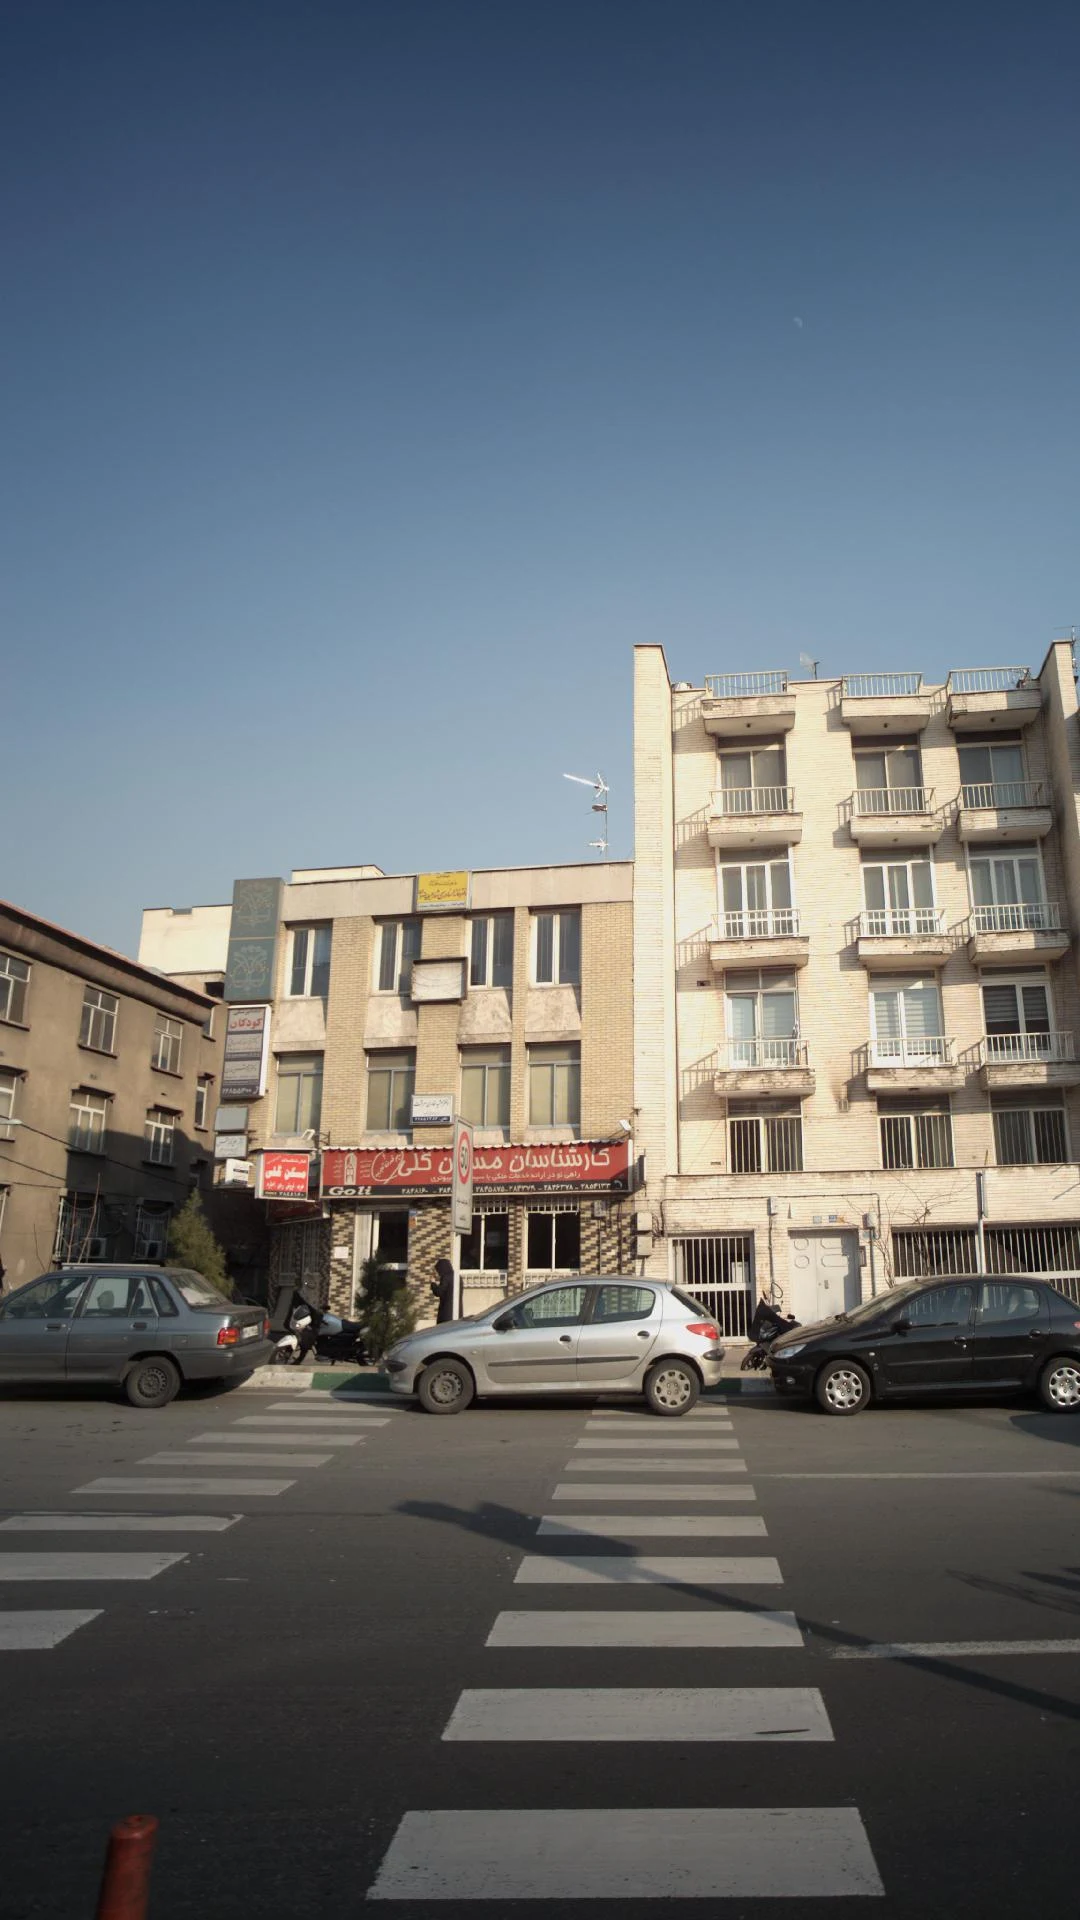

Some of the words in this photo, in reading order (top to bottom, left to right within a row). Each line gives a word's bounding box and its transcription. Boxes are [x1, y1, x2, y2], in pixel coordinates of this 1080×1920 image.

[230, 1017, 262, 1029] کودکان
[509, 1147, 610, 1173] کارشناسان
[328, 1185, 373, 1196] Goli
